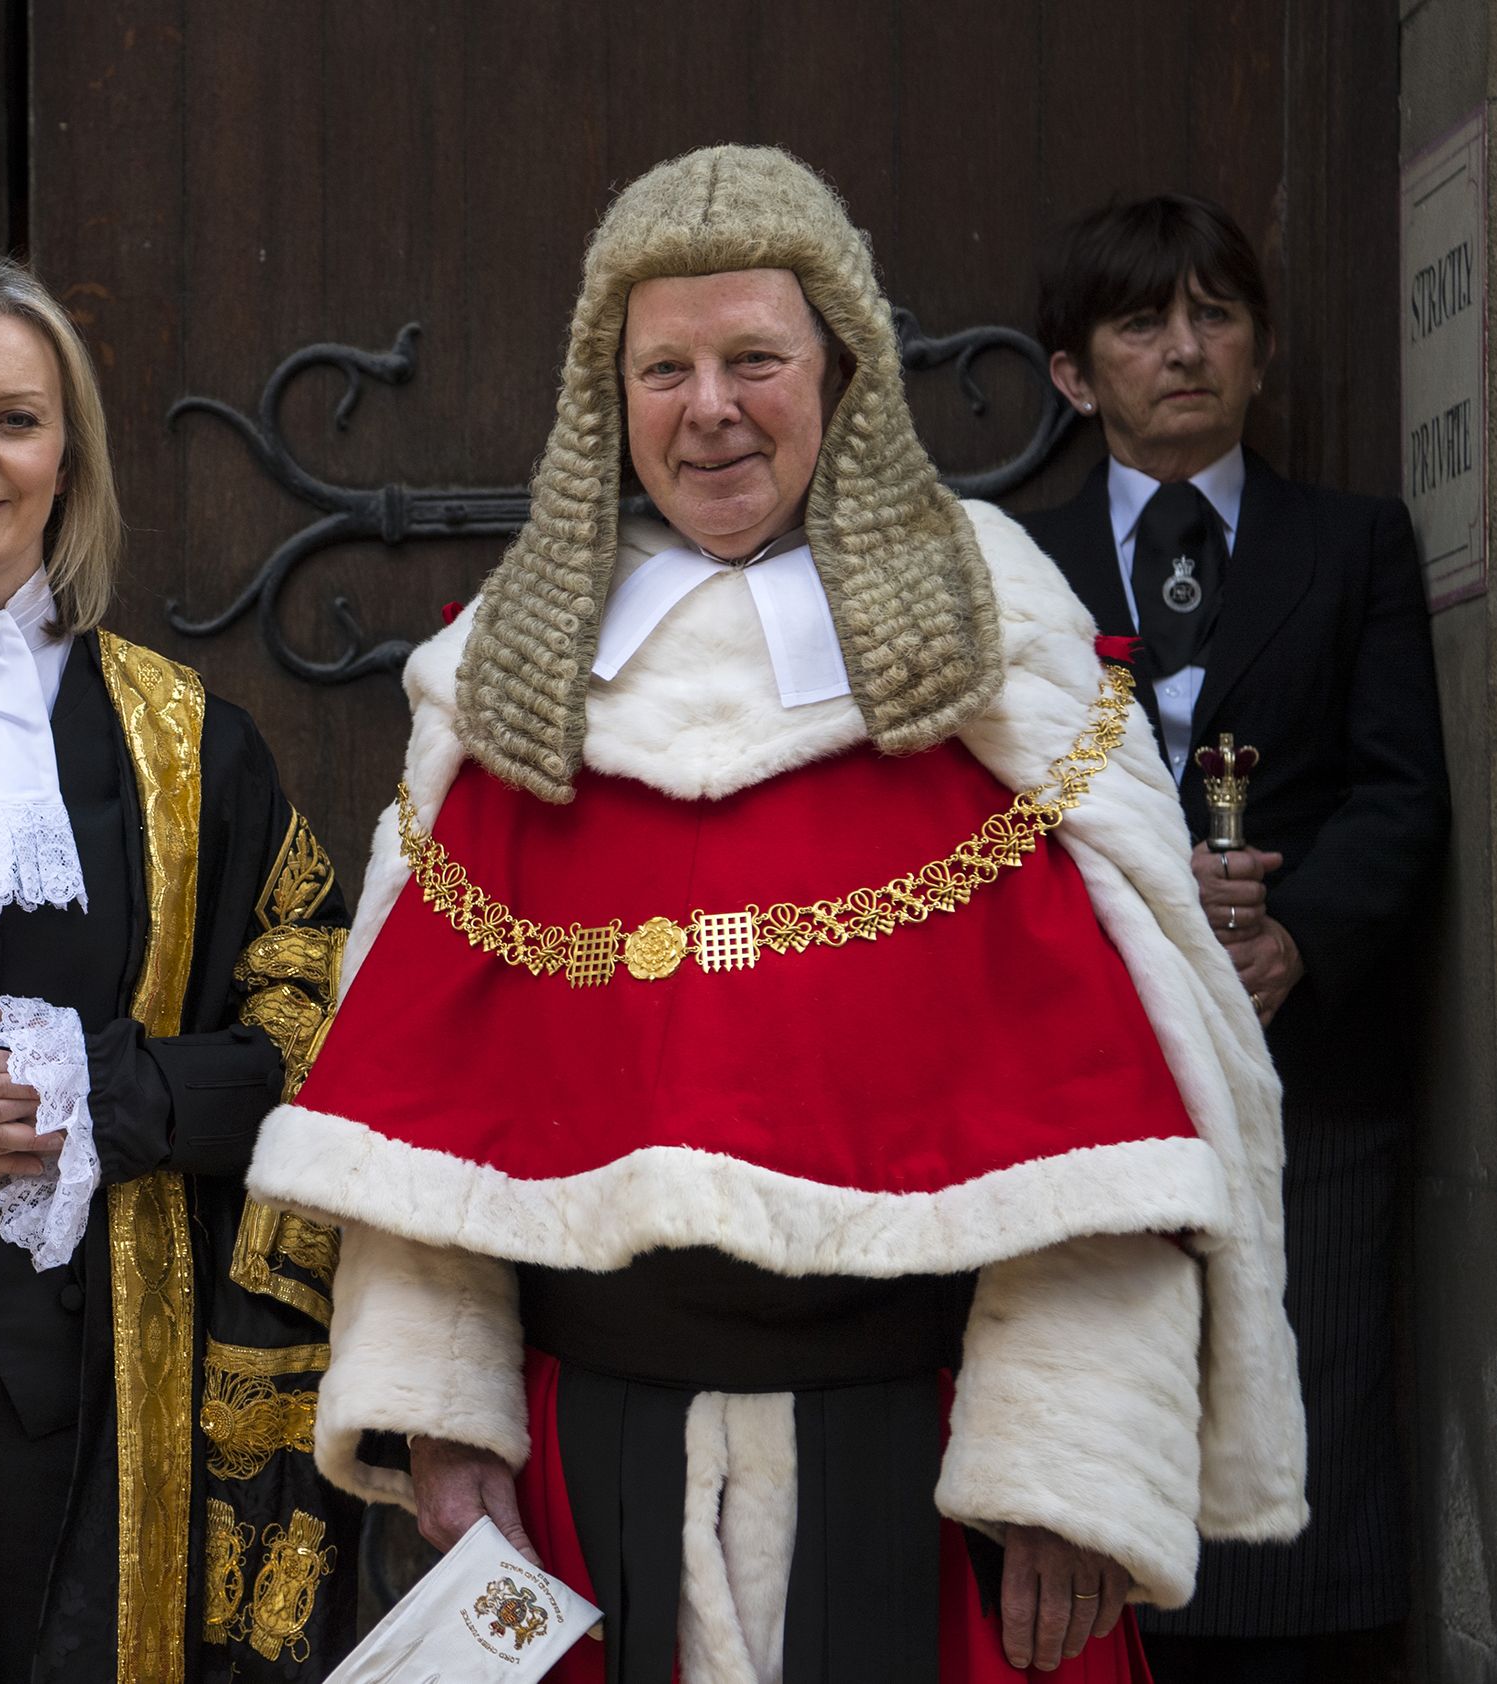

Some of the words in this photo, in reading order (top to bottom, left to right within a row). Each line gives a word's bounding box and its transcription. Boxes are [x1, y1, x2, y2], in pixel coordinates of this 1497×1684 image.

[1411, 241, 1474, 344] STRICTLY
[1411, 398, 1472, 498] PRIVATE
[500, 1561, 524, 1574] WALES
[524, 1571, 540, 1583] AND
[538, 1582, 561, 1614] ENGLAND
[460, 1608, 480, 1637] JUSTICE
[477, 1637, 498, 1654] CHIEF
[499, 1652, 520, 1664] LORD
